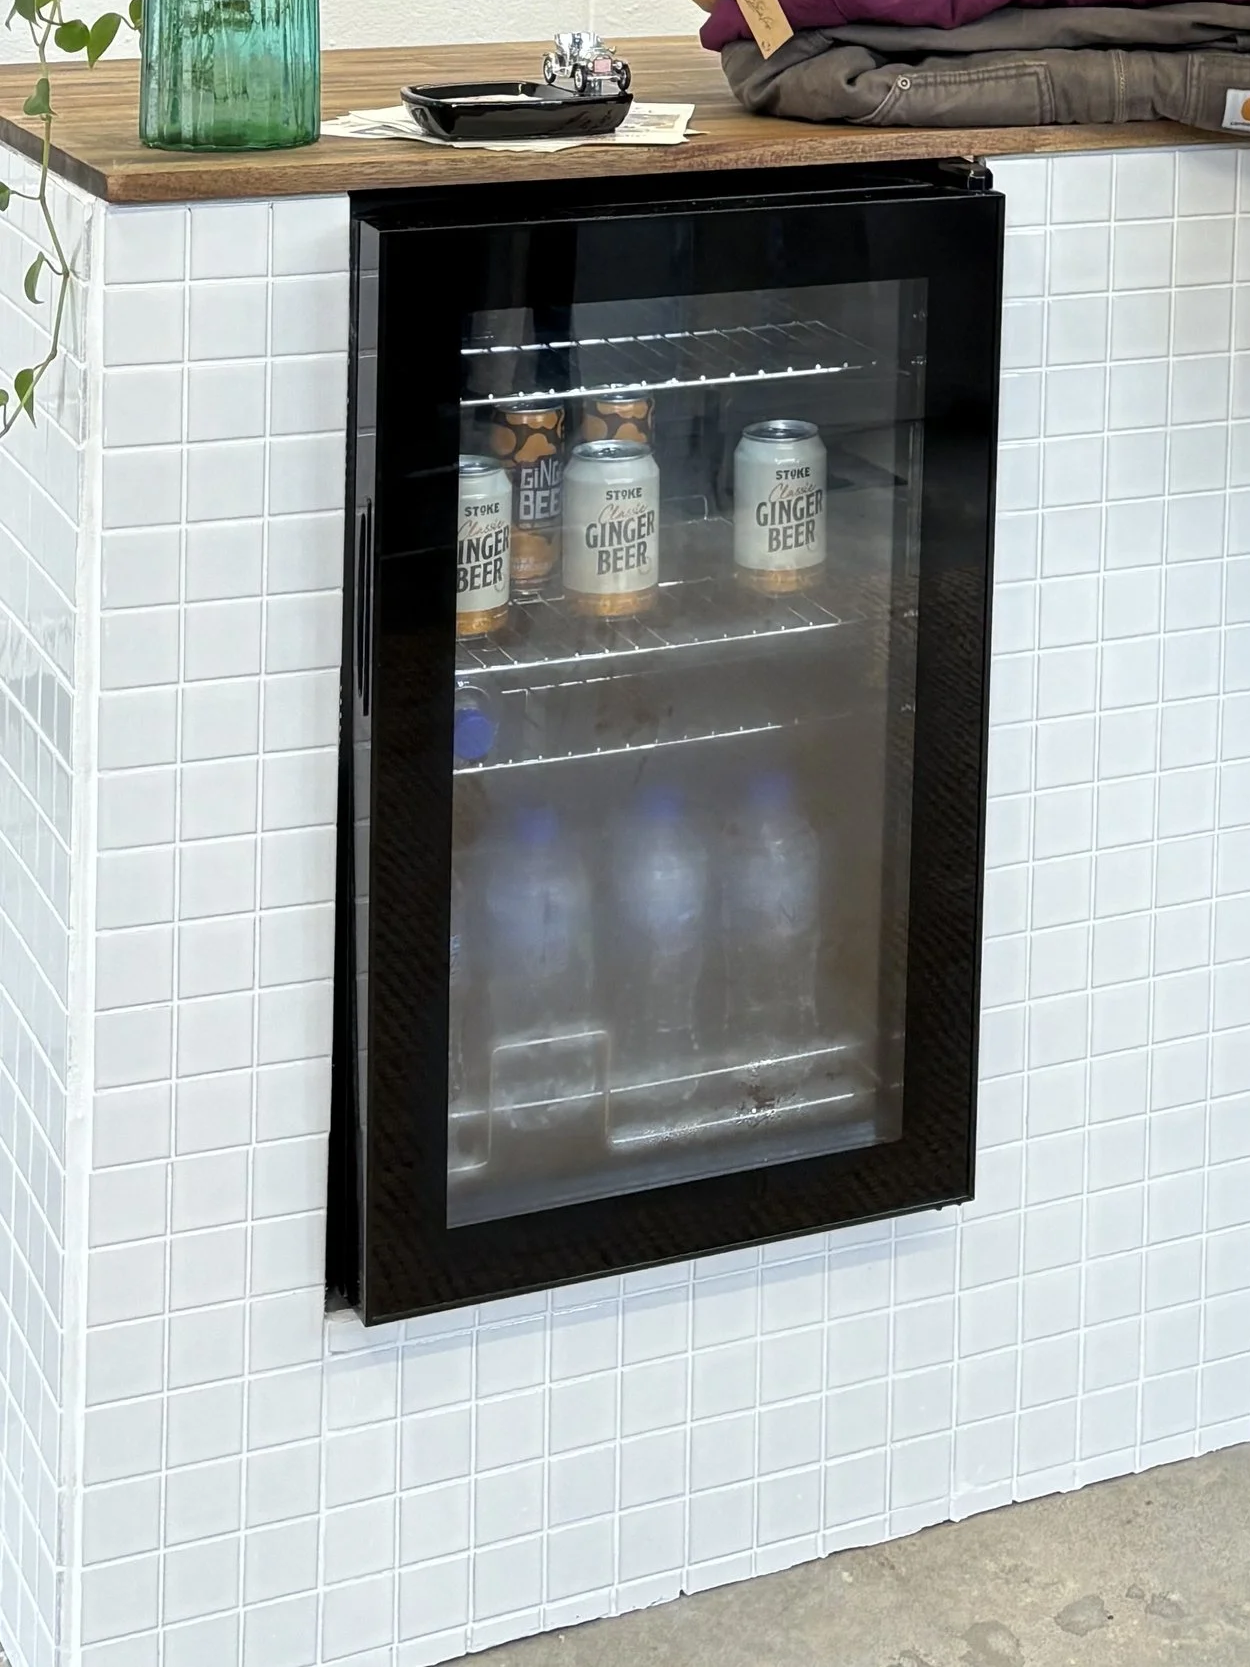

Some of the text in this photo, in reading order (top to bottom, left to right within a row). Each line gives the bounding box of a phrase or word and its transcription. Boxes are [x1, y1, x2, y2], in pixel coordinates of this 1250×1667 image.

[775, 466, 811, 481] STOKE
[464, 502, 500, 517] STOKE
[518, 488, 562, 521] BEE
[605, 487, 643, 501] STOKE
[755, 489, 824, 527] GINGER
[458, 524, 510, 565] INGER
[585, 509, 656, 549] GINGER
[767, 519, 816, 553] BEER
[456, 556, 504, 594] BEER
[597, 540, 648, 576] BEER
